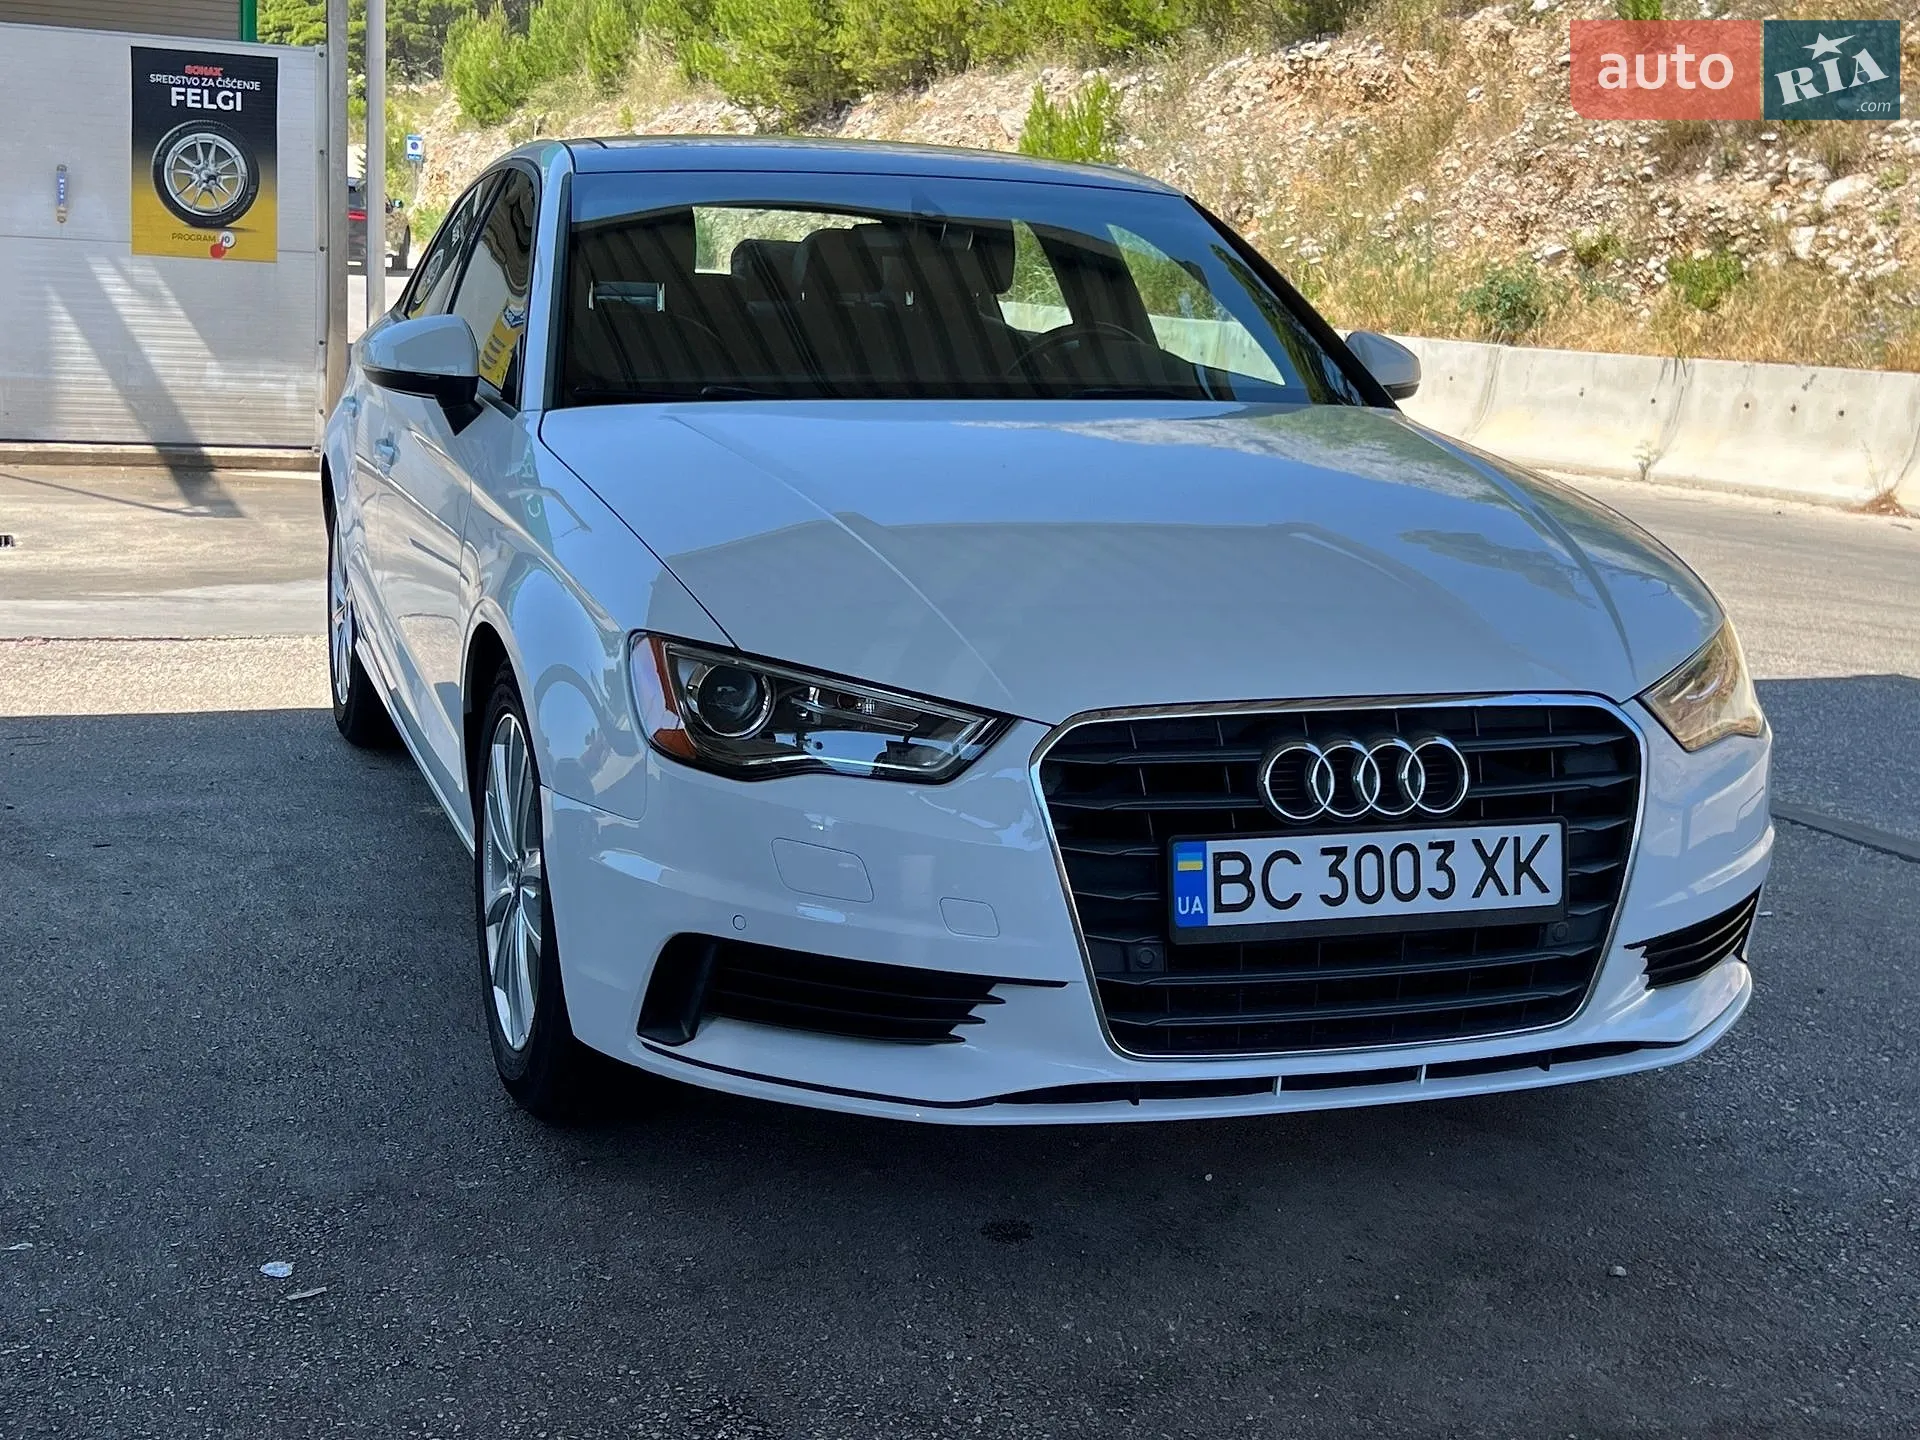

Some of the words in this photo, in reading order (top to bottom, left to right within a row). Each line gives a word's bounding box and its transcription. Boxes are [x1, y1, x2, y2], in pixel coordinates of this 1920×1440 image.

[149, 73, 200, 86] SREDSTVO
[201, 77, 215, 87] ZA
[171, 86, 242, 111] FELGI
[171, 232, 217, 242] PROGRAM
[1212, 849, 1303, 914] BC
[1319, 840, 1456, 907] 3003
[1471, 834, 1550, 899] XK
[1177, 895, 1204, 915] UA
